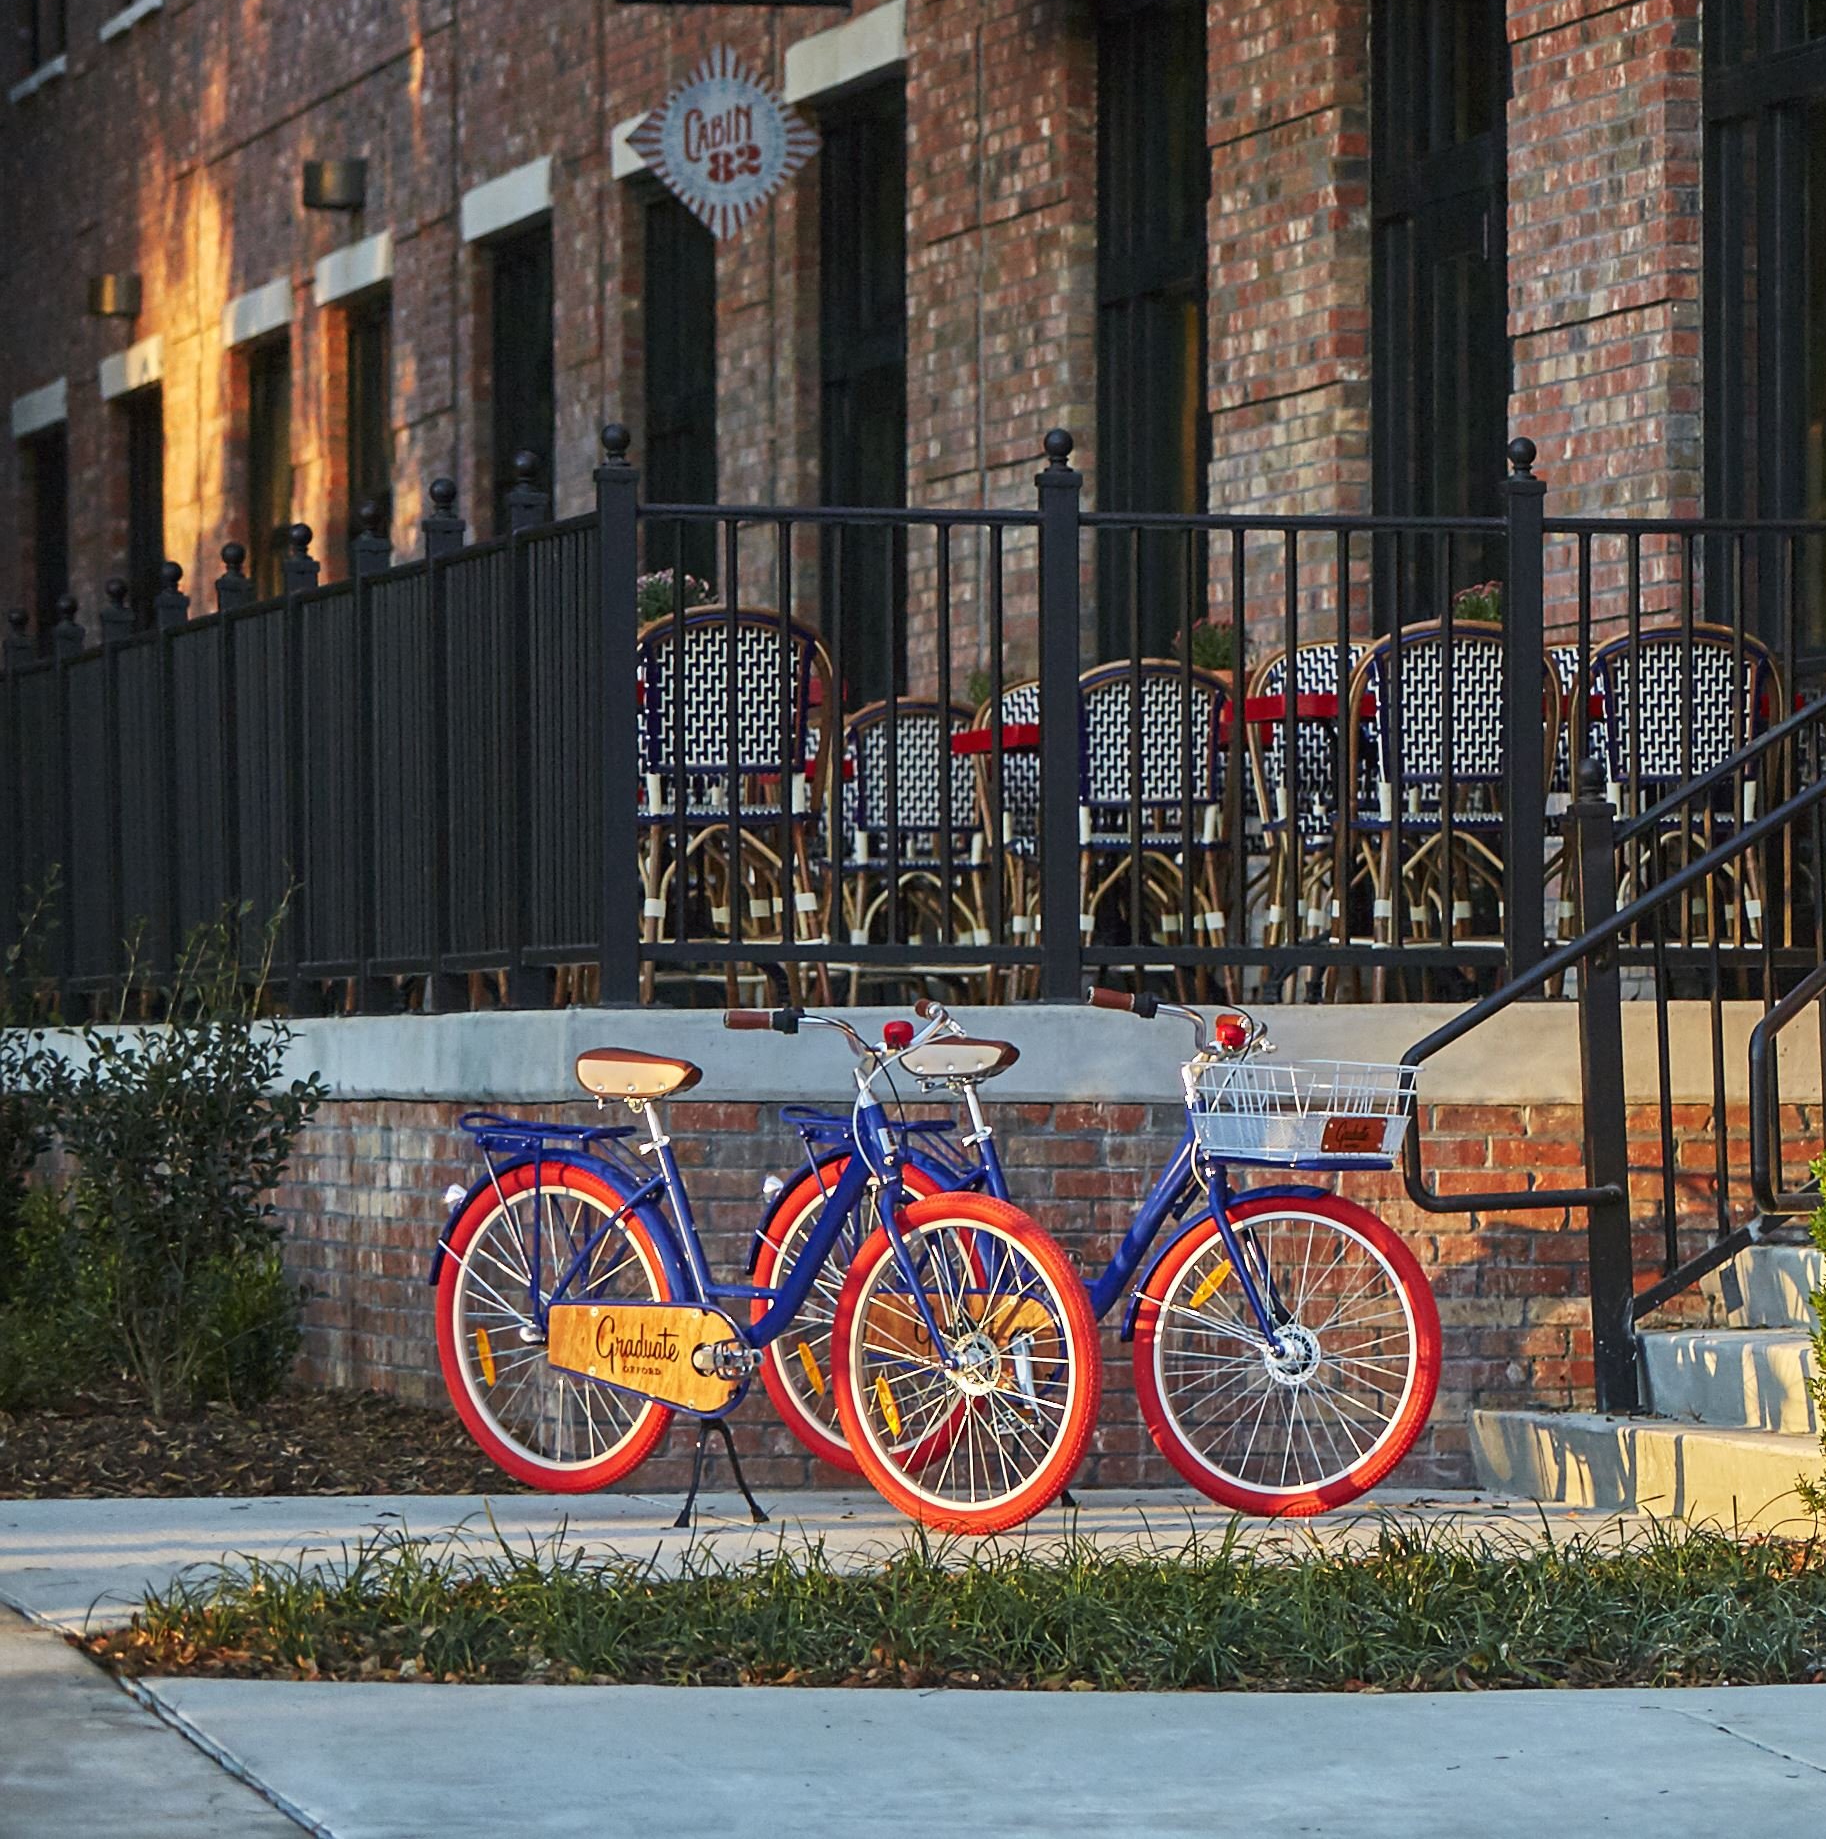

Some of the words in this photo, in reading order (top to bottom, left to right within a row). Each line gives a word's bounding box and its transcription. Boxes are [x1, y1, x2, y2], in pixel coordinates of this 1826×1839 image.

[684, 104, 753, 163] CABIN
[708, 144, 761, 184] 82
[596, 1315, 679, 1374] Graduate
